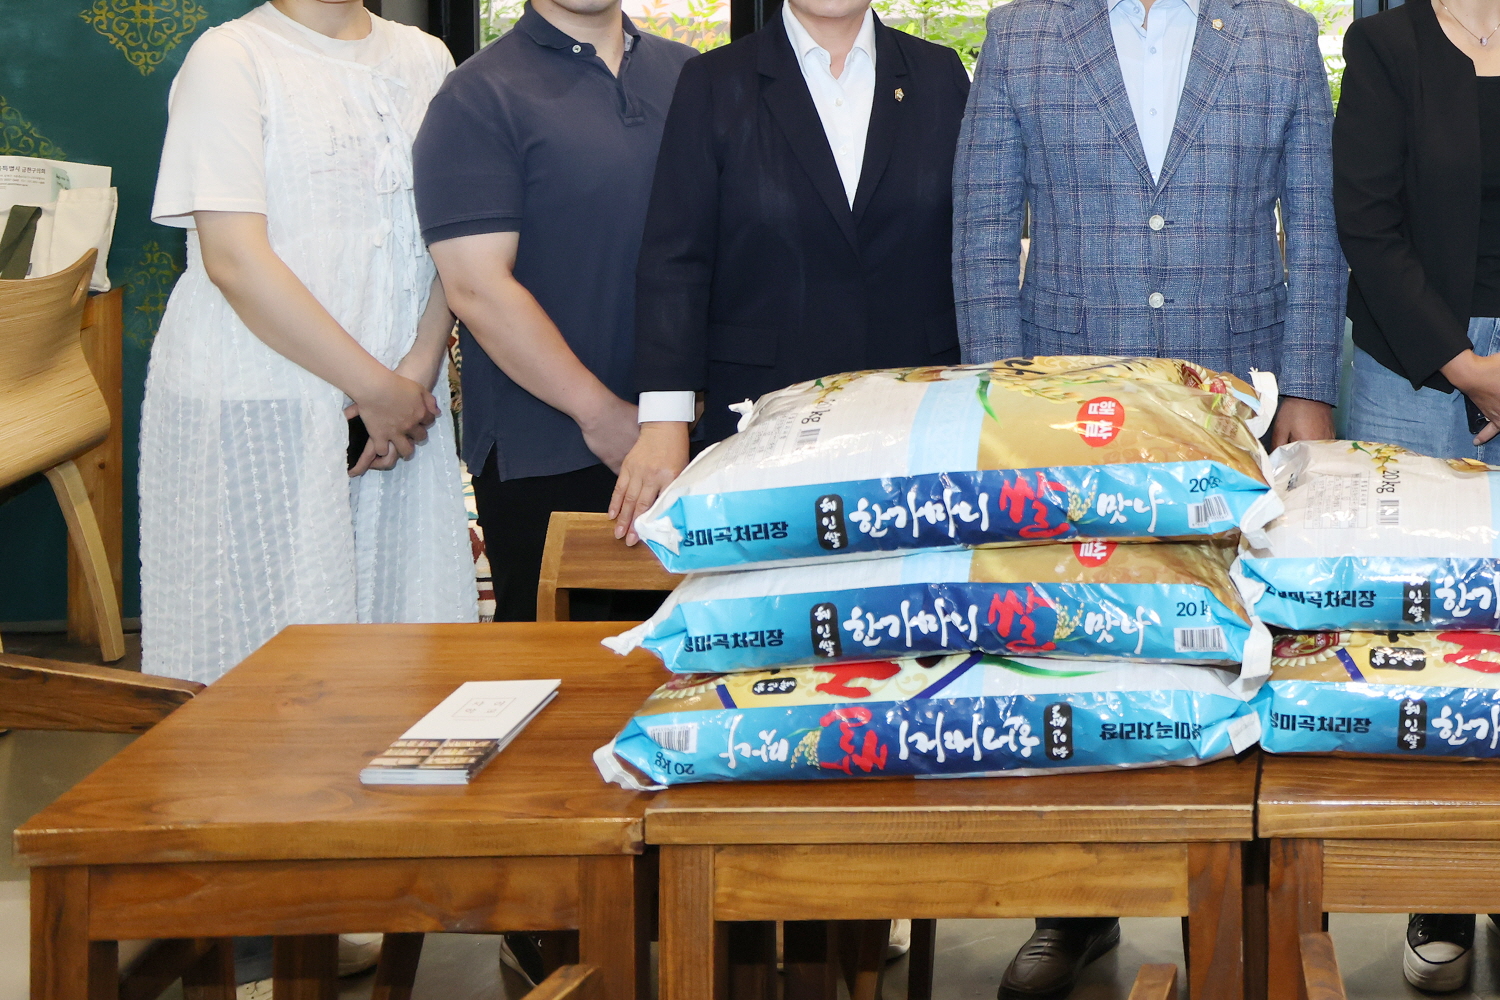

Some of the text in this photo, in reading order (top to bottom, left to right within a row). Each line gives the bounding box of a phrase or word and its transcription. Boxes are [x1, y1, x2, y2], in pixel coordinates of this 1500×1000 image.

[1084, 400, 1117, 440] 햅쌀
[849, 471, 1070, 538] 한가마니 쌀
[1097, 480, 1166, 533] 맛나
[842, 586, 1057, 652] 한가마니 쌀
[1084, 605, 1151, 655] 맛나
[1176, 601, 1197, 617] 20
[719, 713, 789, 769] 맛나
[820, 707, 1041, 775] 한가마니 쌀
